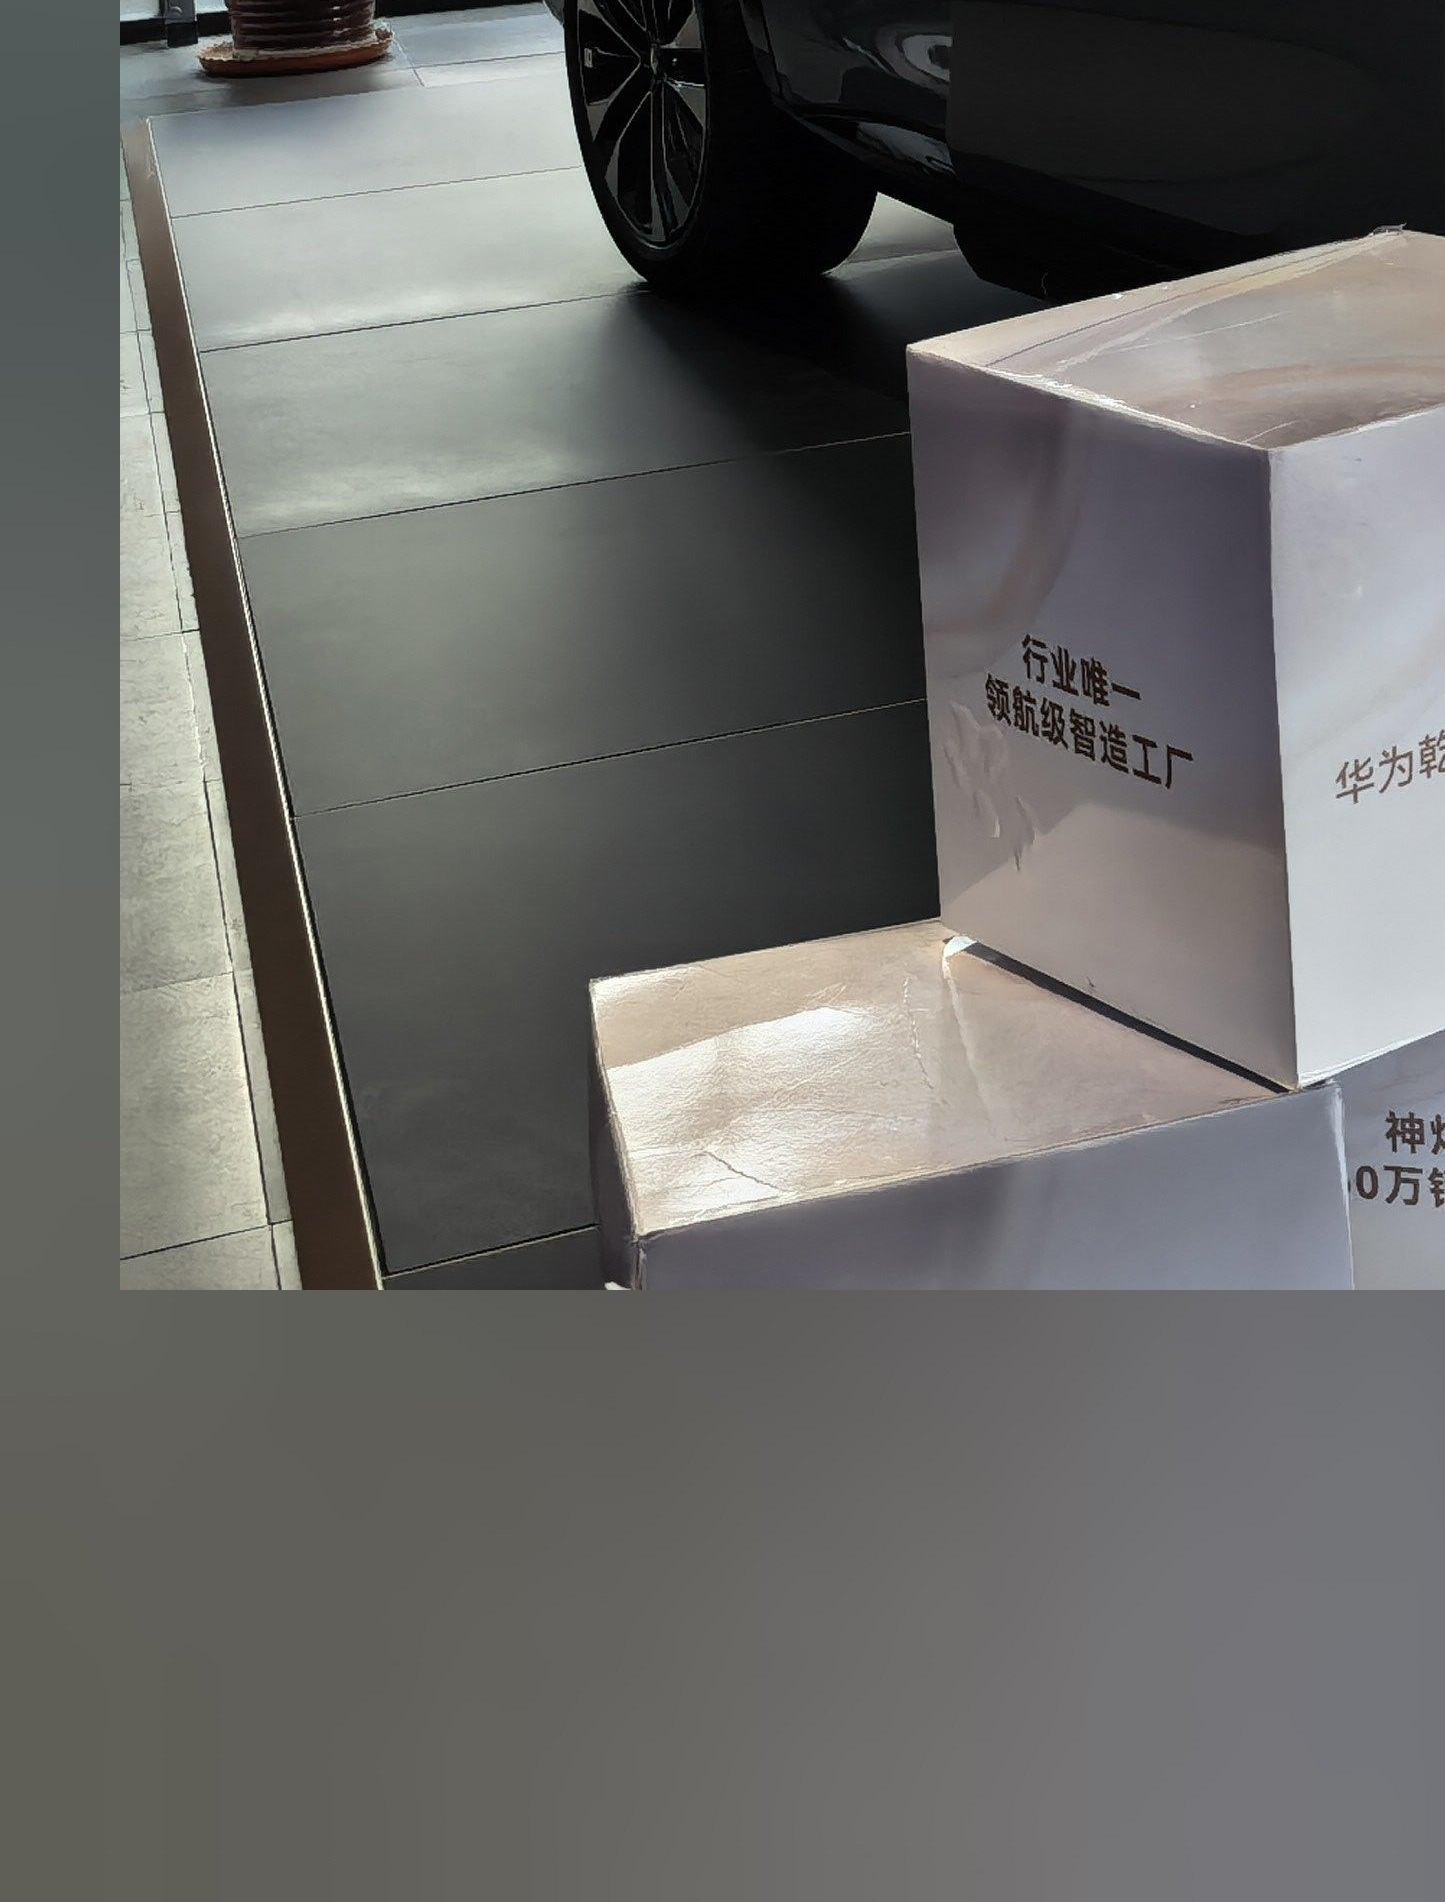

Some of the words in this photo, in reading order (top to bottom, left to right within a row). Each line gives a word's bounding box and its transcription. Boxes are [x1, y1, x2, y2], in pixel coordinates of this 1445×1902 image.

[1021, 633, 1142, 707] 行业唯一
[984, 672, 1194, 790] 领航级智造工厂
